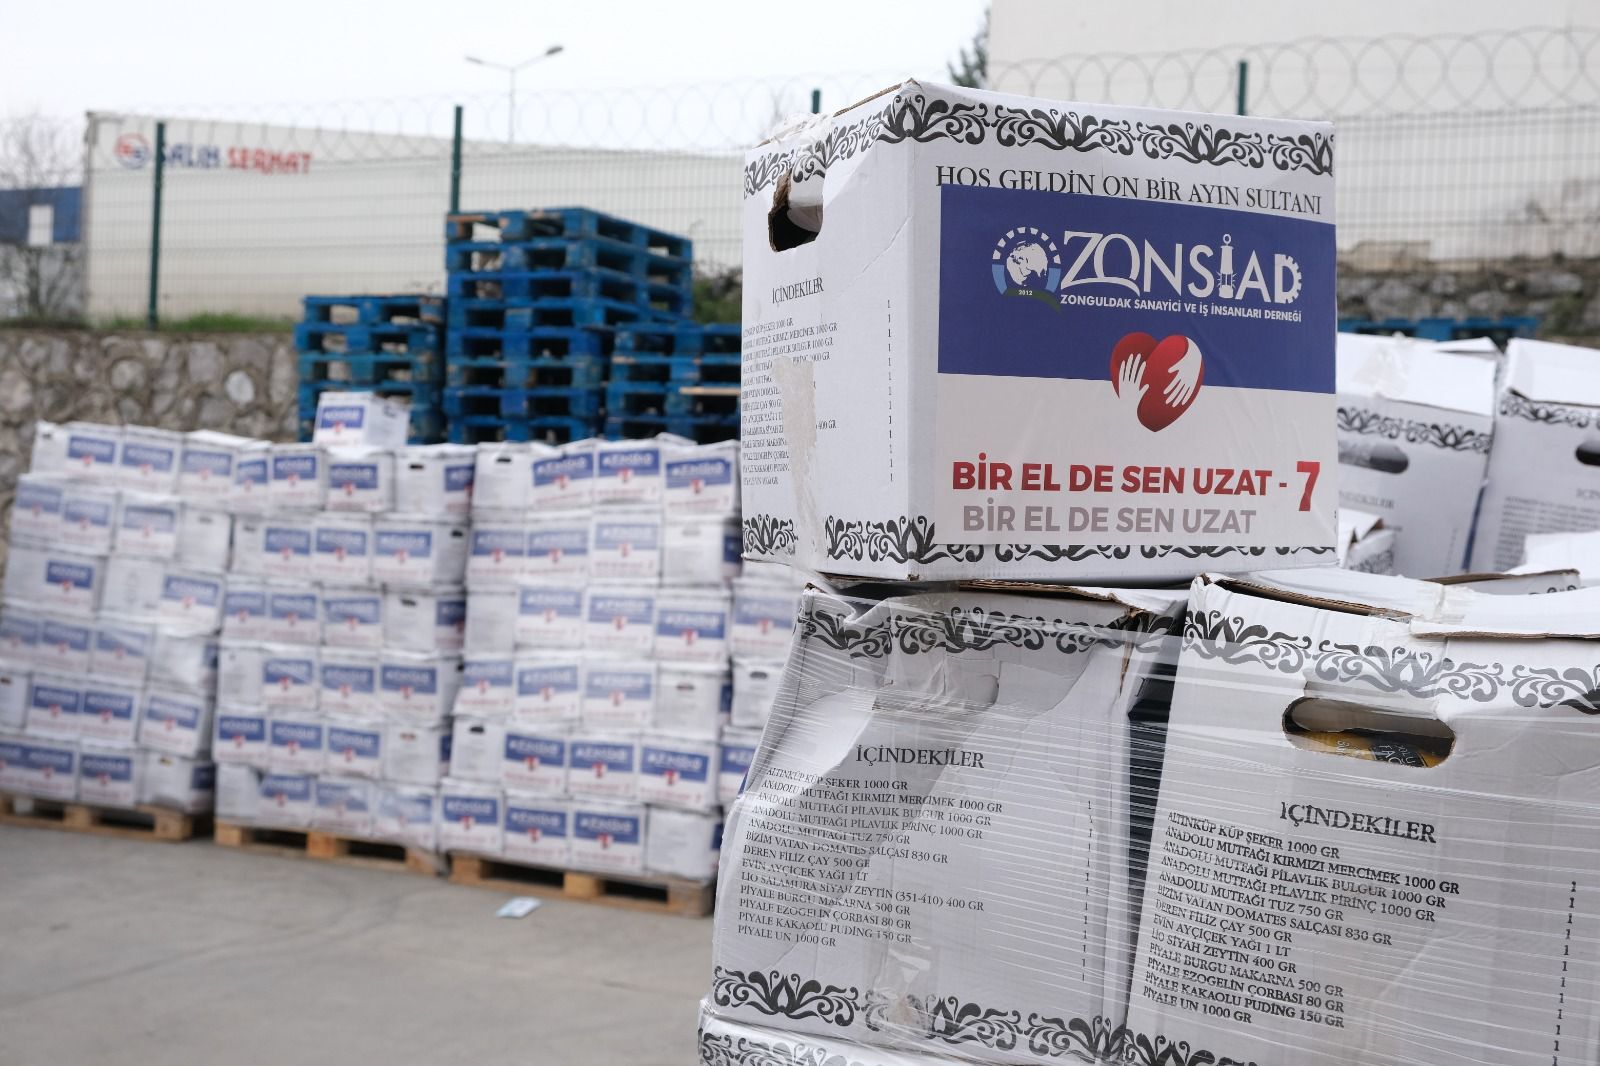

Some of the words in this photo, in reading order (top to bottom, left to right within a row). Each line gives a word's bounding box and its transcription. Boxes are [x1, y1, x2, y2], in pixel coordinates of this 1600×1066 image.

[999, 169, 1095, 194] GELDİN
[1103, 175, 1139, 198] ON
[1146, 177, 1182, 201] BİR
[1188, 183, 1240, 206] AYIN
[1246, 188, 1321, 214] SULTANI
[772, 277, 824, 307] İÇİNDEKİLER
[1060, 294, 1131, 308] ZONGULDAK
[1134, 298, 1181, 312] SANAYİCİ
[1184, 302, 1197, 313] VE
[1200, 302, 1209, 316] İŞ
[1211, 303, 1261, 318] İNSANLARI
[1264, 308, 1302, 322] DERNEĞİ
[952, 452, 1013, 490] BİR
[1021, 463, 1061, 491] EL
[1069, 465, 1114, 492] DE
[1120, 466, 1185, 494] SEN
[1193, 468, 1272, 496] UZAT
[1297, 460, 1320, 512] 7
[963, 497, 1016, 532] BİR
[1024, 506, 1060, 532] EL
[1068, 507, 1109, 532] DE
[1116, 508, 1174, 533] SEN
[1182, 509, 1256, 534] UZAT
[856, 745, 984, 768] İÇİNDEKİLER
[762, 780, 799, 794] ANADOLU
[800, 787, 848, 801] MUTFAĞI
[852, 792, 896, 802] KIRMIZI
[959, 800, 984, 811] 1000
[987, 802, 1002, 813] GR
[825, 778, 860, 789] ŞEKER
[864, 780, 889, 789] 1000
[892, 780, 908, 790] GR
[798, 814, 847, 828] MUTFAĞI
[851, 818, 898, 830] PİLAVLIK
[940, 826, 964, 837] 1000
[966, 829, 983, 839] GR
[799, 801, 848, 814] MUTFAĞI
[852, 805, 900, 817] PİLAVLIK
[948, 812, 972, 823] 1000
[975, 816, 991, 826] GR
[1280, 802, 1436, 843] İÇİNDEKİLER
[744, 845, 776, 858] DEREN
[780, 851, 805, 863] FİLİZ
[808, 856, 830, 866] ÇAY
[833, 859, 852, 867] 500
[746, 831, 772, 844] BİZİM
[775, 837, 808, 850] VATAN
[869, 847, 909, 859] SALÇASI
[911, 851, 930, 861] 830
[933, 854, 948, 863] GR
[896, 835, 910, 844] GR
[1287, 841, 1317, 854] 1000
[1320, 846, 1340, 859] GR
[818, 870, 844, 880] YAĞI
[857, 872, 868, 881] LT
[1163, 840, 1213, 863] ANADOLU
[1214, 855, 1268, 878] MUTFAĞI
[1271, 869, 1328, 888] PİLAVLIK
[1332, 879, 1387, 898] BULGUR
[1391, 890, 1422, 904] 1000
[1425, 895, 1446, 908] GR
[1165, 825, 1215, 848] ANADOLU
[1216, 840, 1270, 862] MUTFAĞI
[1273, 854, 1325, 872] KIRMIZI
[1328, 863, 1400, 884] MERCİMEK
[1405, 876, 1435, 890] 1000
[1439, 881, 1460, 894] GR
[741, 885, 775, 899] PİYALE
[875, 902, 893, 913] 500
[895, 905, 911, 915] GR
[854, 885, 893, 899] ZEYTİN
[896, 891, 943, 907] (351-410)
[946, 897, 965, 908] 400
[968, 900, 984, 911] GR
[1160, 871, 1209, 893] ANADOLU
[1211, 885, 1265, 907] MUTFAĞI
[1268, 899, 1295, 912] TUZ
[1298, 904, 1321, 916] 750
[1325, 909, 1344, 921] GR
[1161, 855, 1210, 878] ANADOLU
[1213, 870, 1267, 892] MUTFAĞI
[1270, 884, 1327, 903] PİLAVLIK
[1330, 894, 1377, 914] PİRİNÇ
[1381, 903, 1411, 918] 1000
[1415, 910, 1435, 922] GR
[739, 912, 773, 926] PİYALE
[776, 918, 827, 931] KAKAOLU
[830, 924, 873, 938] PUDİNG
[877, 931, 894, 940] 150
[896, 934, 912, 943] GR
[740, 898, 774, 912] PİYALE
[833, 910, 878, 925] ÇORBASI
[881, 917, 893, 927] 80
[896, 920, 911, 929] GR
[1156, 899, 1187, 918] DEREN
[1189, 909, 1217, 926] FİLİZ
[1220, 919, 1245, 932] ÇAY
[1248, 926, 1270, 938] 500
[1274, 930, 1292, 942] GR
[1158, 884, 1182, 902] BİZİM
[1185, 894, 1223, 912] VATAN
[1226, 905, 1287, 926] DOMATES
[1290, 918, 1342, 936] SALÇASI
[1345, 928, 1369, 941] 830
[1373, 932, 1392, 945] GR
[738, 924, 772, 938] PİYALE
[775, 931, 791, 942] UN
[796, 934, 819, 945] 1000
[821, 937, 836, 947] GR
[1154, 913, 1174, 930] EVİN
[1230, 936, 1261, 952] YAĞI
[1266, 944, 1271, 953] 1
[1276, 946, 1291, 956] LT
[1150, 942, 1181, 963] PİYALE
[1183, 955, 1227, 973] BURGU
[1230, 966, 1294, 987] MAKARNA
[1298, 979, 1320, 992] 500
[1325, 984, 1344, 997] GR
[1167, 935, 1200, 953] SİYAH
[1203, 944, 1249, 963] ZEYTİN
[1252, 955, 1274, 969] 400
[1278, 961, 1296, 973] GR
[1145, 971, 1178, 992] PİYALE
[1181, 983, 1241, 1006] KAKAOLU
[1244, 998, 1296, 1018] PUDİNG
[1300, 1009, 1322, 1023] 150
[1325, 1014, 1344, 1028] GR
[1148, 957, 1180, 978] PİYALE
[1182, 969, 1244, 992] EZOGELİN
[1247, 984, 1303, 1004] ÇORBASI
[1306, 995, 1321, 1008] 80
[1325, 1000, 1344, 1013] GR
[1144, 985, 1177, 1006] PİYALE
[1180, 998, 1199, 1011] UN
[1202, 1004, 1230, 1018] 1000
[1234, 1010, 1252, 1023] GR
